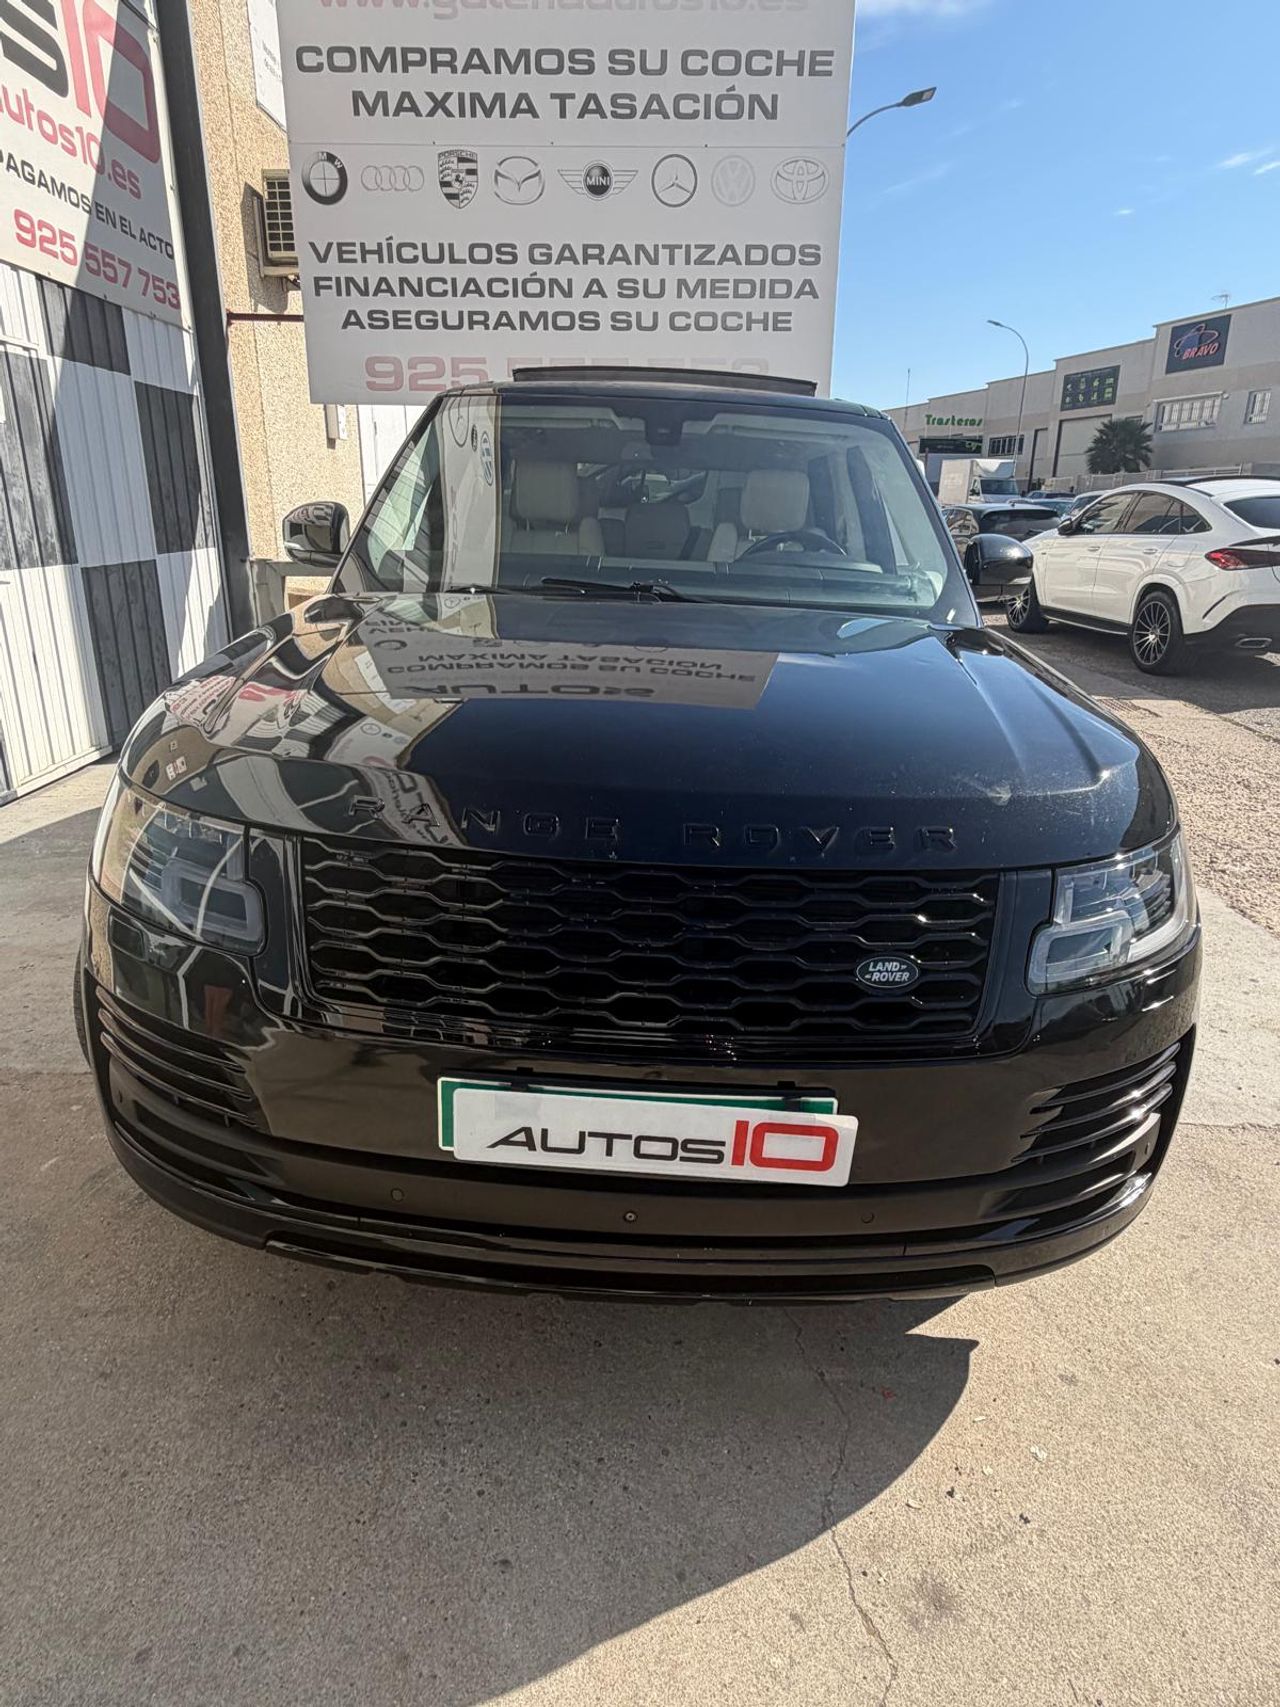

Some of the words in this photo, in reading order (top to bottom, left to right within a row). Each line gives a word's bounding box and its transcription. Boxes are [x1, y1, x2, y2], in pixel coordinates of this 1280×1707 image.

[295, 45, 596, 76] COMPRAMOS
[607, 48, 668, 76] SU
[680, 49, 835, 77] COCHE
[351, 89, 540, 119] MAXIMA
[550, 84, 779, 120] TASACIÓN
[0, 84, 142, 200] utos10.es
[586, 175, 611, 187] MINI
[0, 149, 92, 215] AGAMOS
[95, 201, 117, 230] EN
[119, 216, 137, 240] EL
[139, 227, 175, 261] ACTO
[14, 208, 78, 267] 925
[84, 242, 133, 289] 557
[137, 267, 182, 310] 753
[308, 235, 520, 265] VEHÍCULOS
[528, 243, 822, 266] GARANTIZADOS
[312, 271, 574, 299] FINANCIACIÓN
[582, 278, 608, 299] A
[617, 278, 666, 299] SU
[675, 278, 820, 300] MEDIDA
[340, 309, 601, 331] ASEGURAMOS
[610, 311, 659, 331] SU
[668, 311, 793, 332] COCHE
[1182, 343, 1220, 361] BRAVO
[364, 355, 490, 393] 925
[925, 414, 983, 427] Trasteros
[349, 794, 620, 841] RANGE
[682, 822, 958, 855] ROVER
[868, 961, 900, 972] LAND
[871, 971, 910, 982] ROVER
[486, 1119, 840, 1172] AUTOS10
